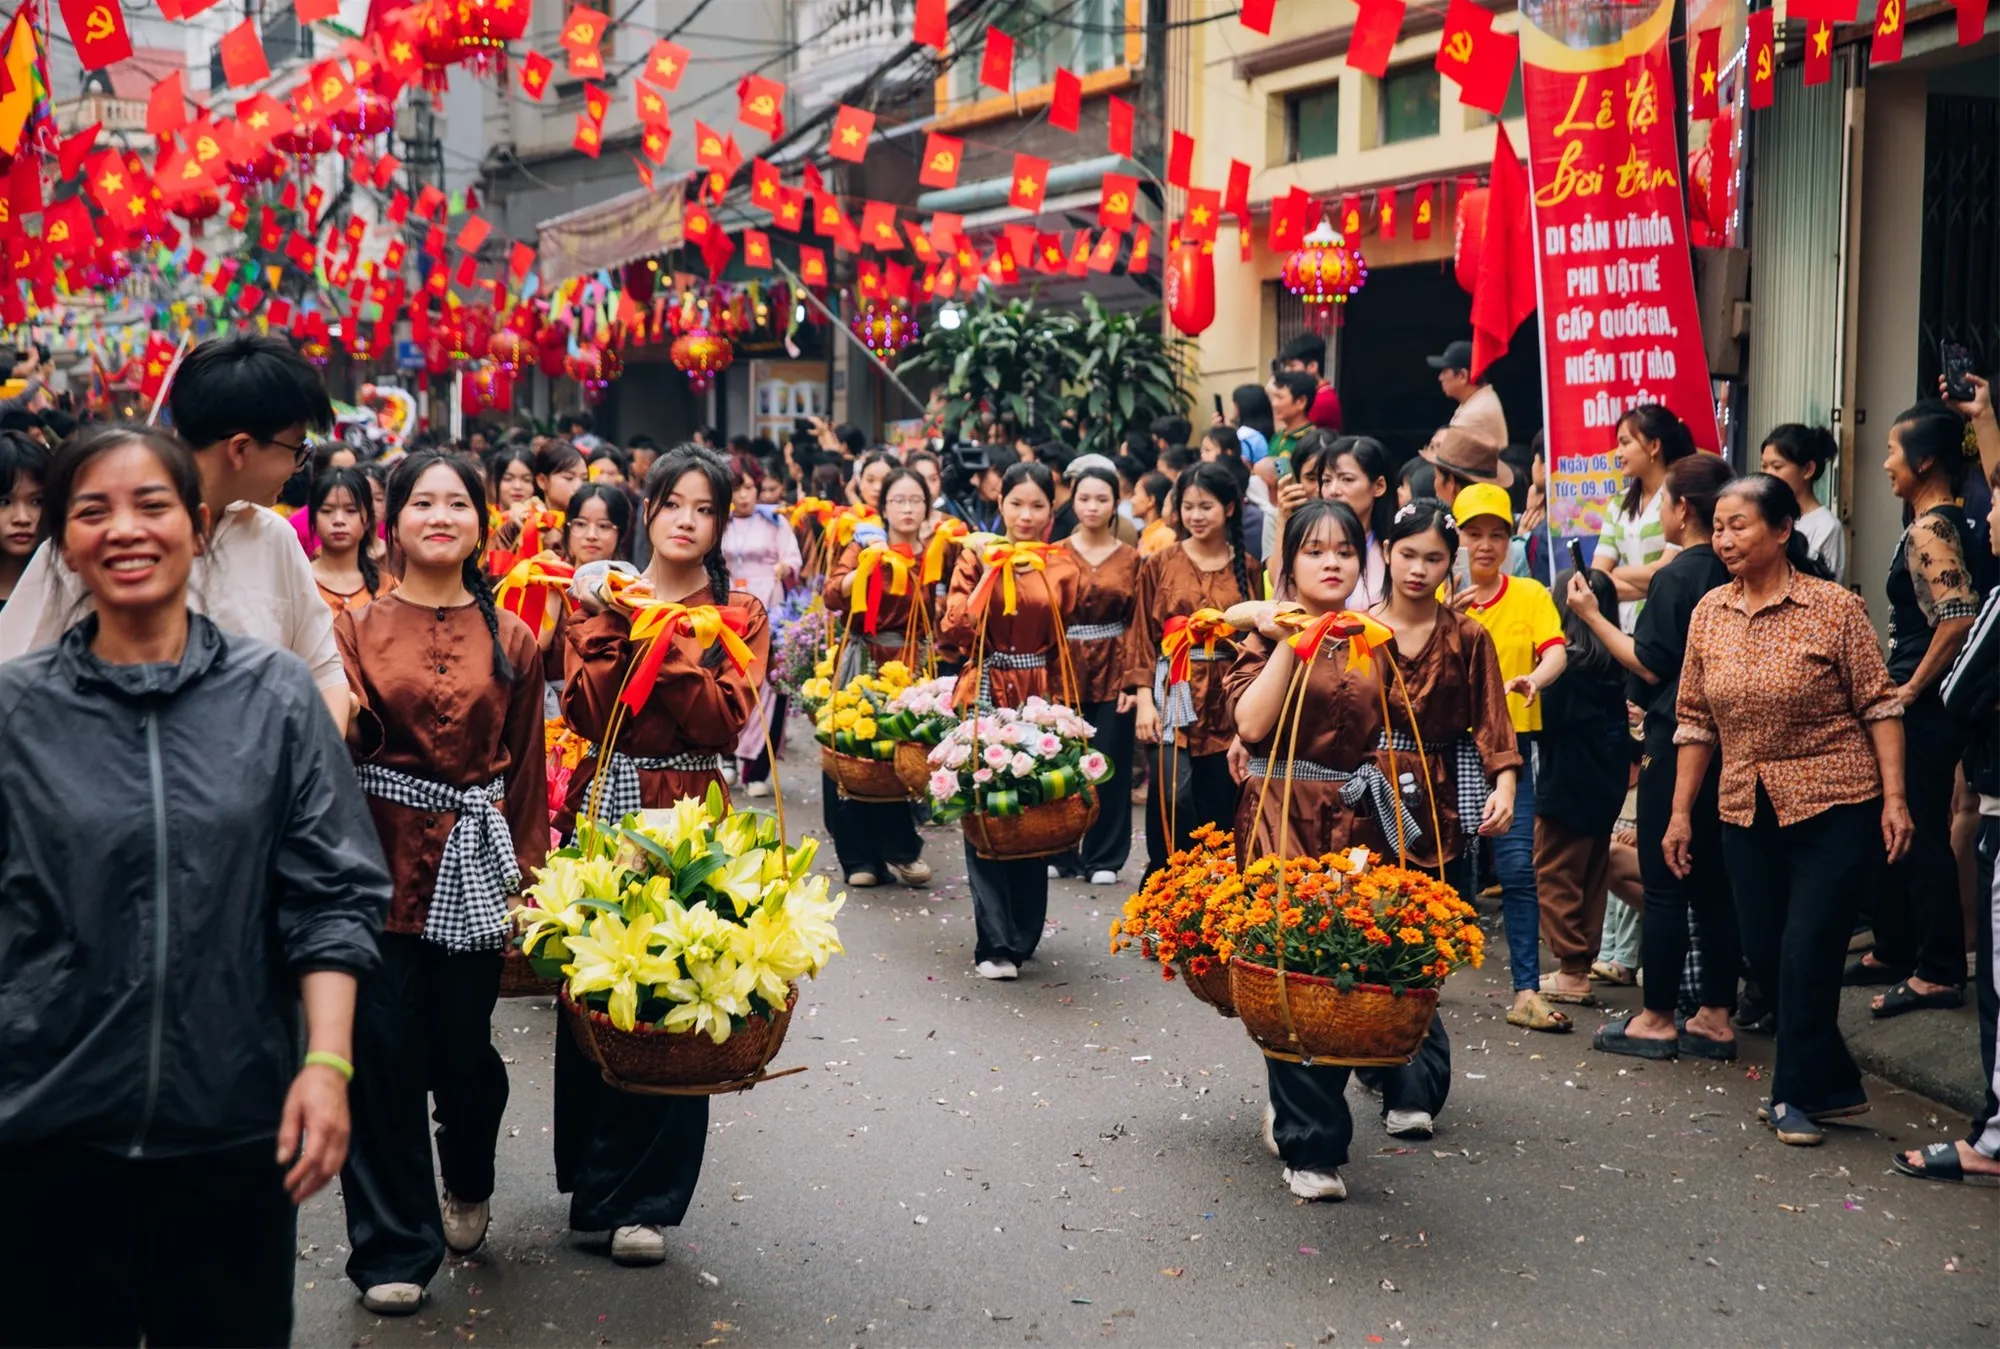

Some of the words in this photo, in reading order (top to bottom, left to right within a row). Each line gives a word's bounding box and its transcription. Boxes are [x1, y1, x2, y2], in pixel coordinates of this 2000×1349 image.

[1553, 75, 1616, 137] Lễ
[1545, 225, 1566, 256] DI
[1570, 213, 1610, 253] SẢN
[1566, 265, 1599, 298] PHI
[1603, 257, 1640, 299] VẬT
[1556, 304, 1594, 342] CẤP
[1599, 300, 1648, 340] QUỐC
[1619, 348, 1645, 387] TỰ
[1647, 344, 1677, 381] HÀO
[1582, 390, 1622, 429] DÂN
